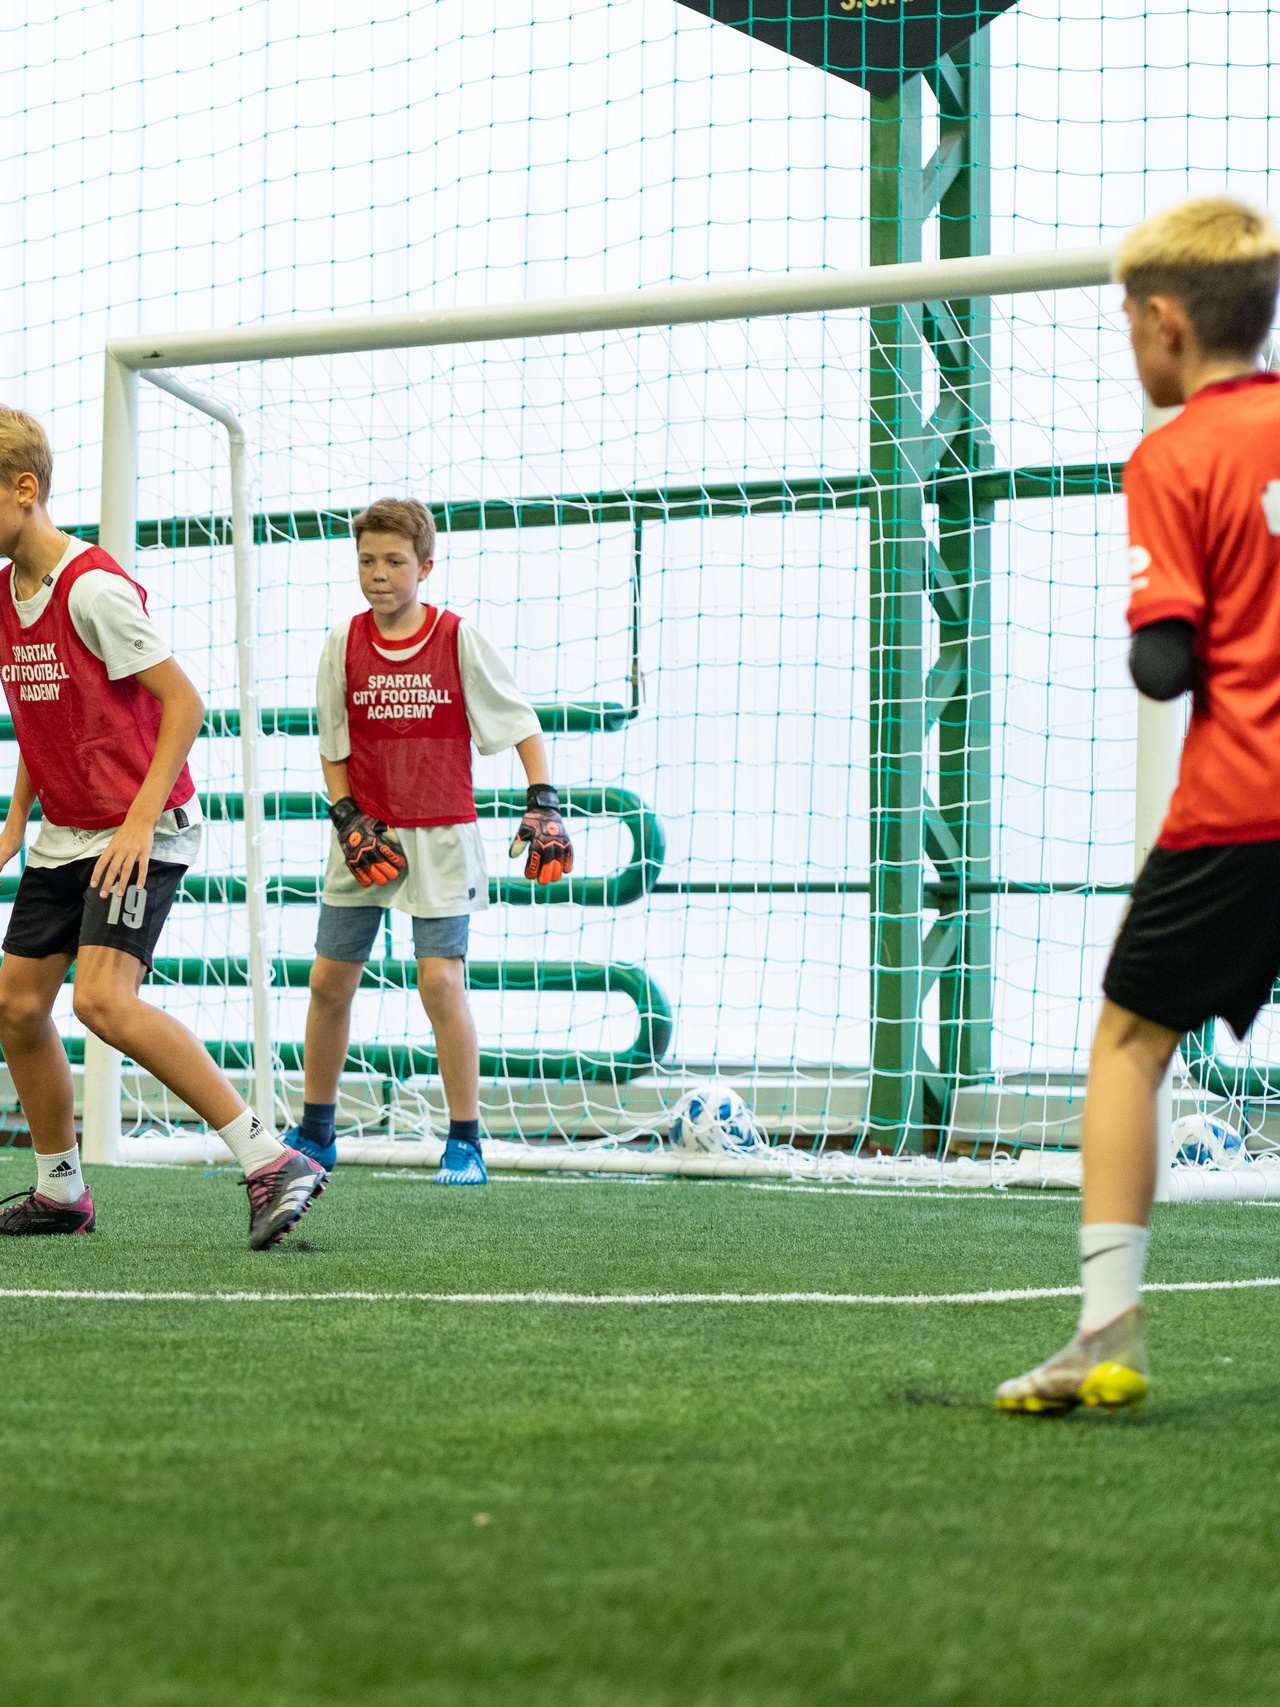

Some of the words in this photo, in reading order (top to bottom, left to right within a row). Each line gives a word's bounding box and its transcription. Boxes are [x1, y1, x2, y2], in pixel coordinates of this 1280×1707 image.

[12, 643, 57, 662] SPARTAK
[368, 674, 432, 689] SPARTAK
[353, 691, 377, 705] CITY
[381, 689, 452, 704] FOOTBALL
[367, 705, 435, 719] ACADEMY
[106, 881, 148, 929] 19
[48, 1168, 77, 1179] adidas
